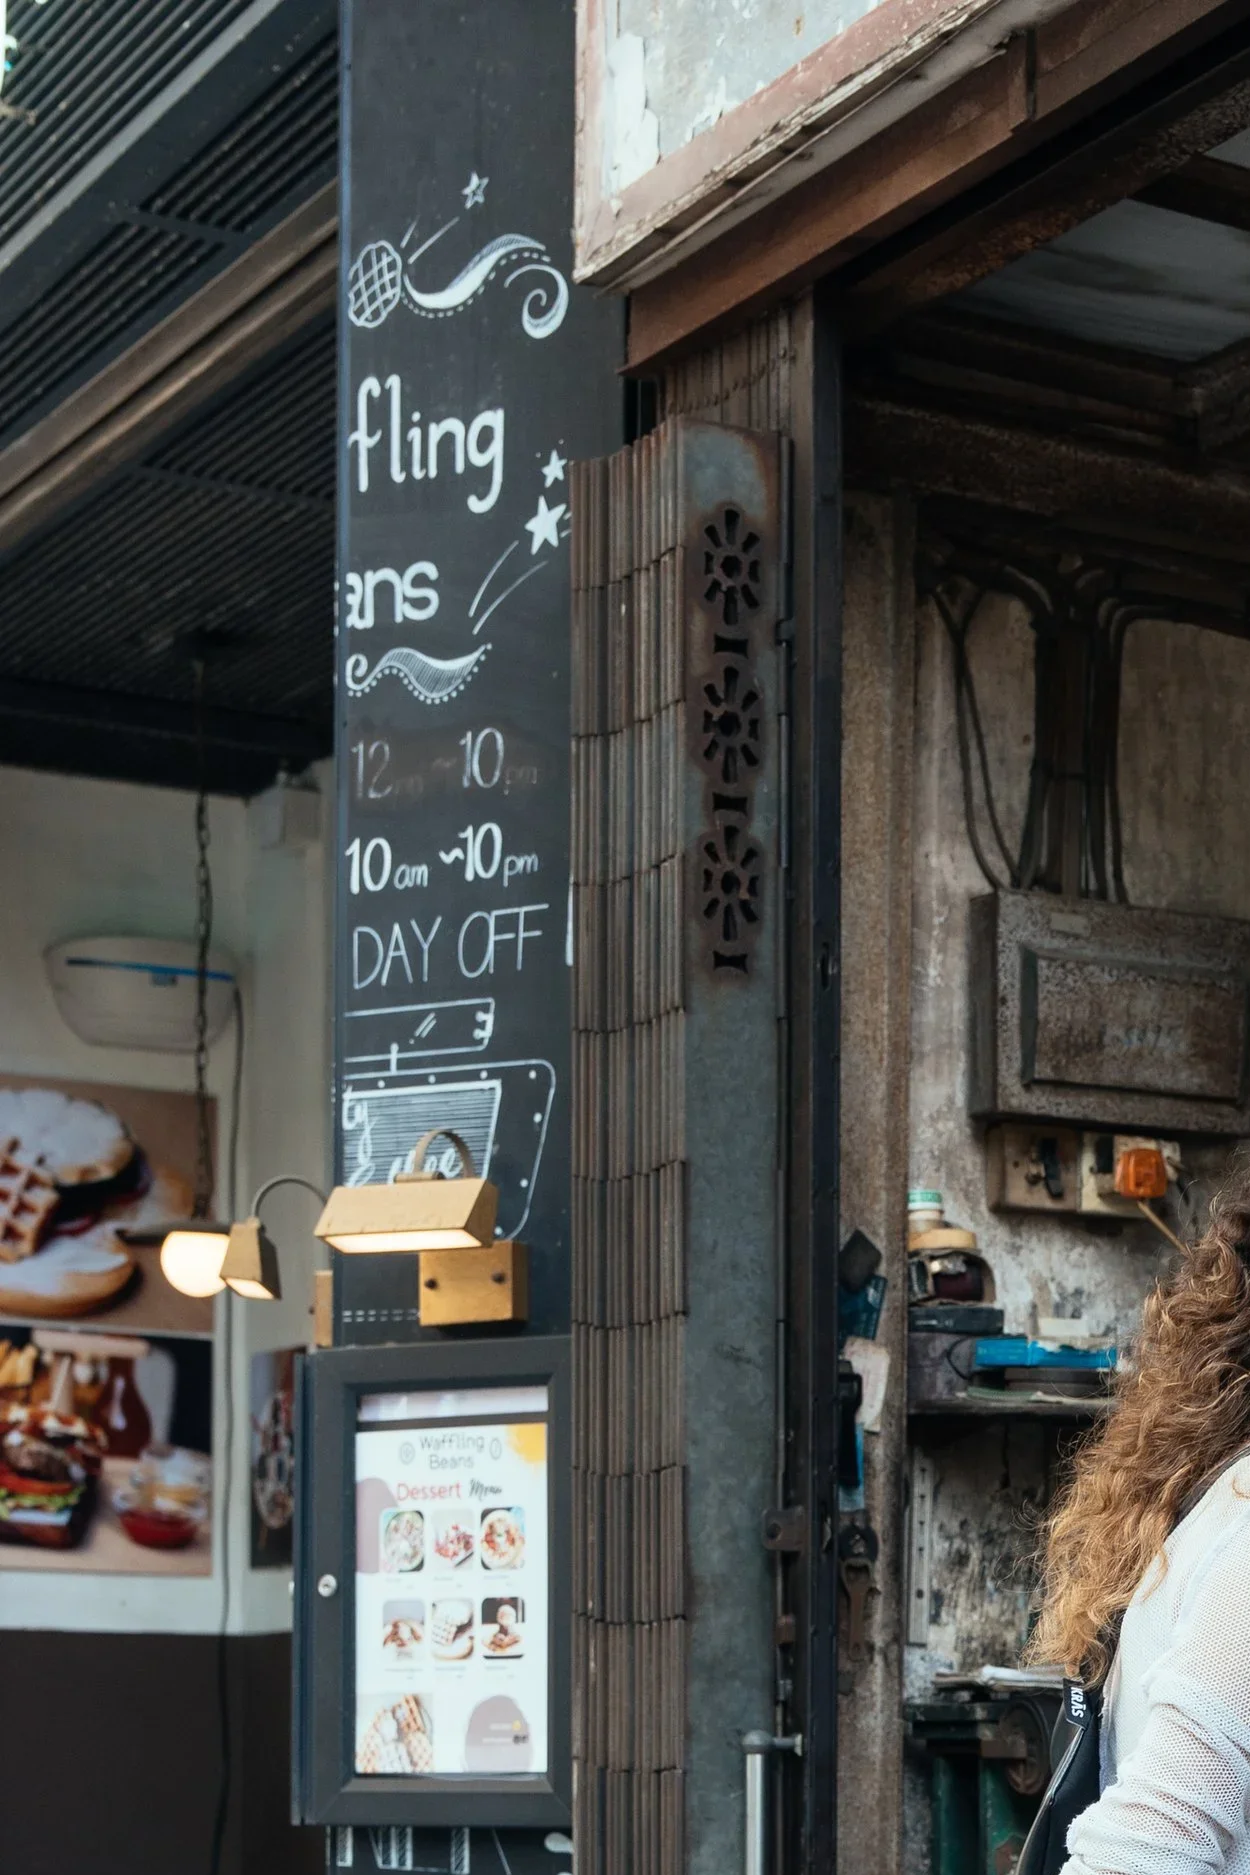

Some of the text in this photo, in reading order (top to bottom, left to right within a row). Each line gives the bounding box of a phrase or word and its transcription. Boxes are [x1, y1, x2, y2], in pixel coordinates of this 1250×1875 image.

[347, 374, 505, 514] fling
[352, 903, 550, 990] DAY OFF
[397, 1481, 462, 1502] Dessert
